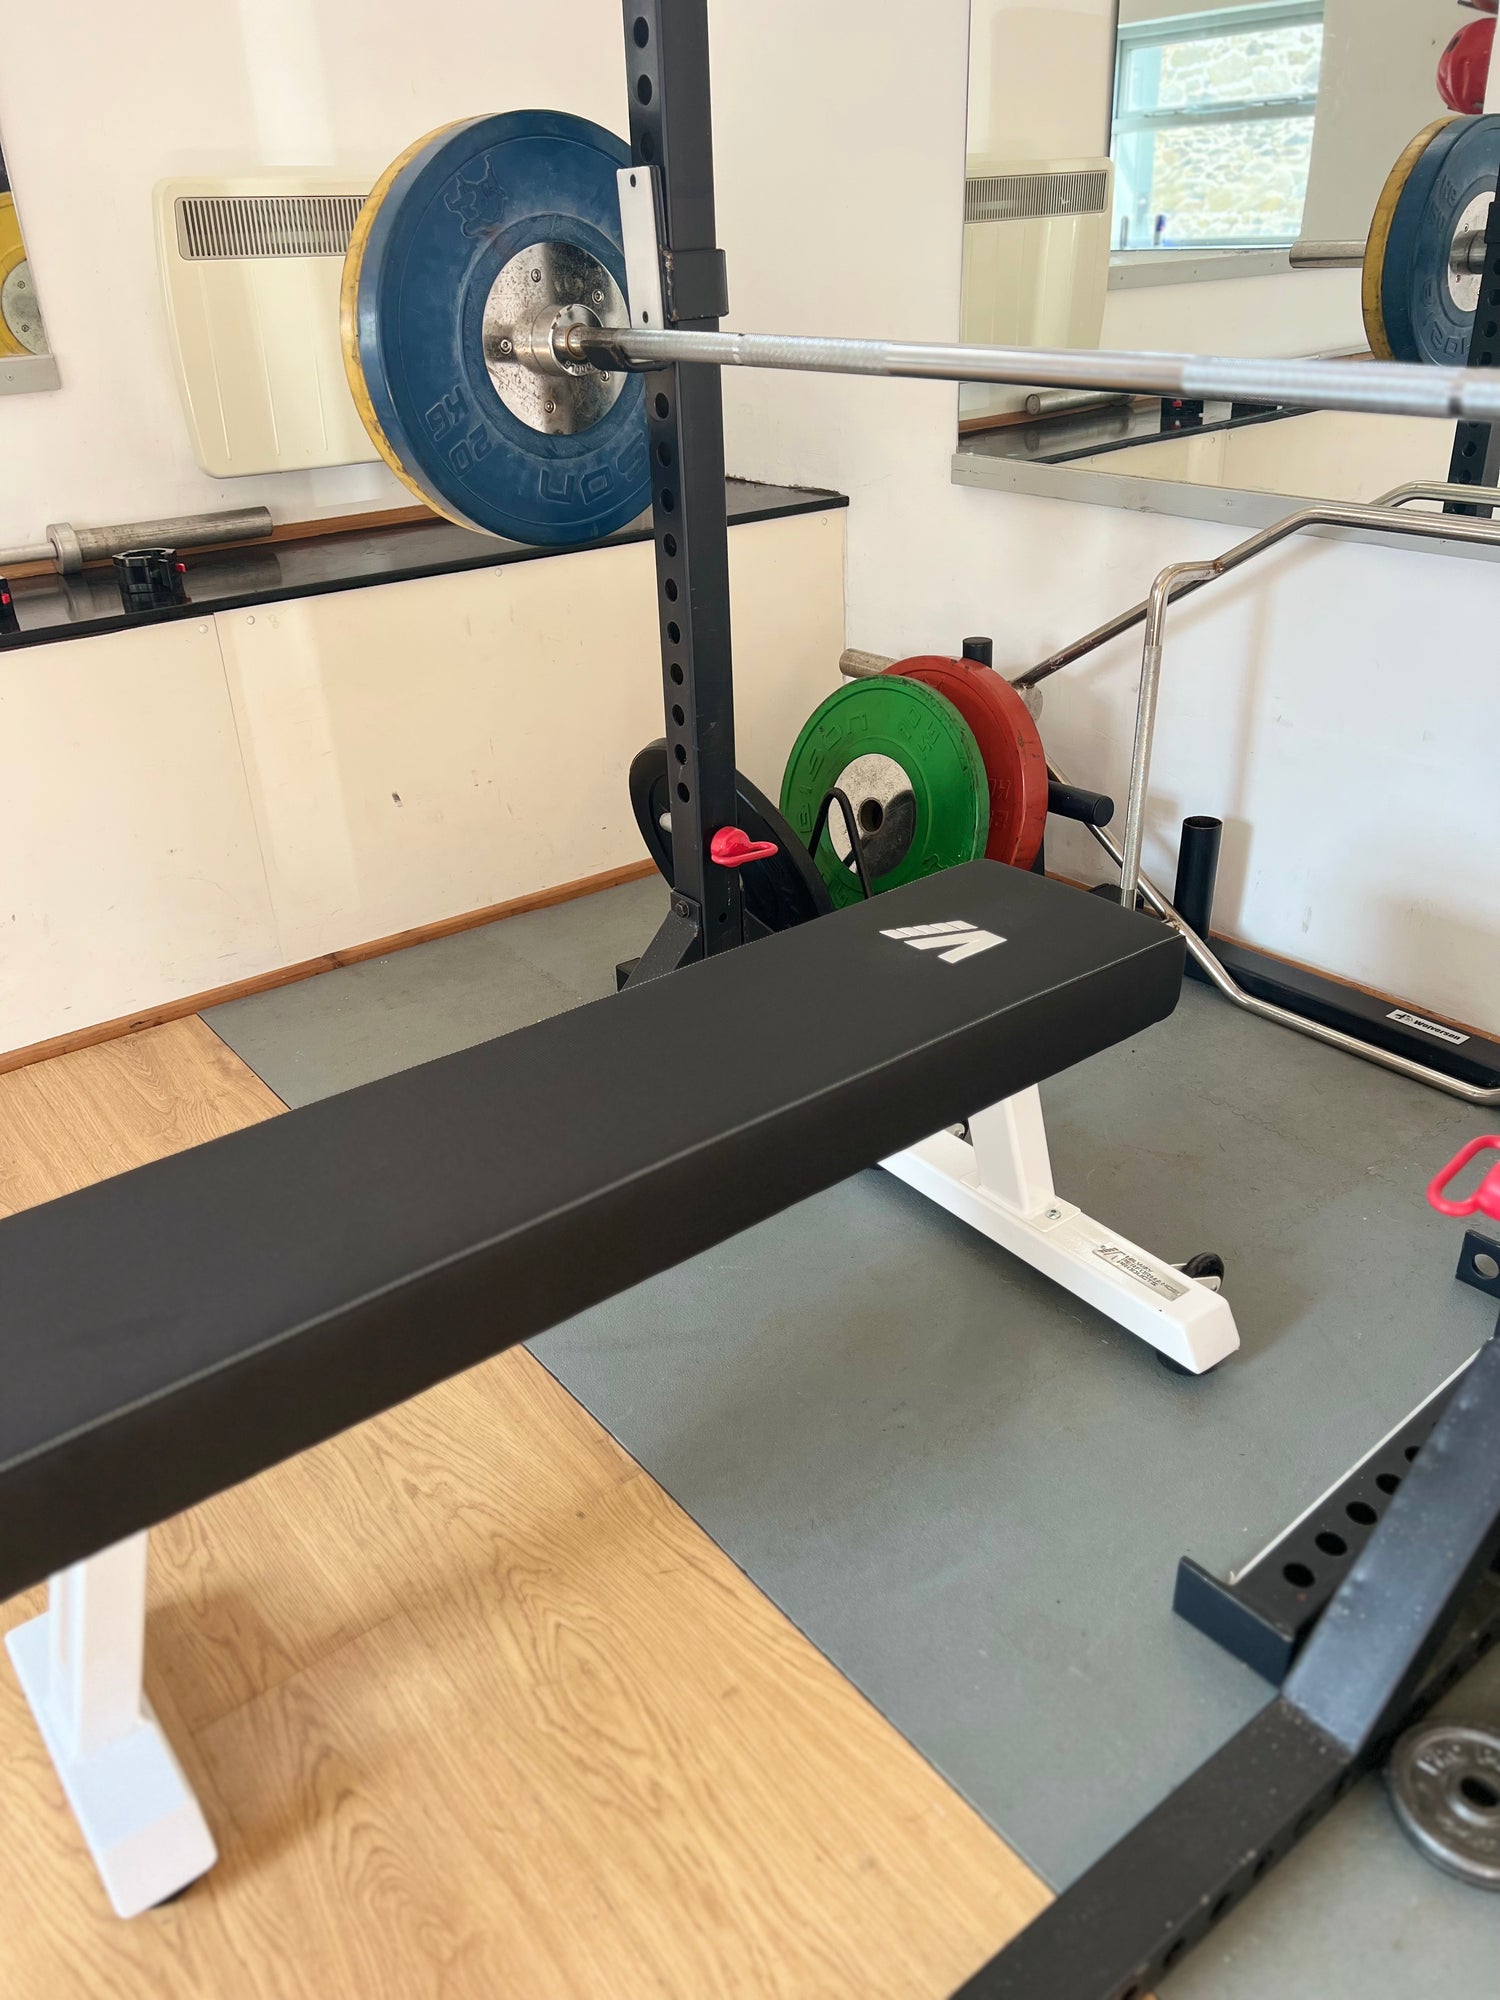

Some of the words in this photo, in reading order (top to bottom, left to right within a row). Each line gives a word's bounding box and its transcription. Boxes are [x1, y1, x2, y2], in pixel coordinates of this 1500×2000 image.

[425, 384, 470, 441] KG
[448, 422, 492, 479] 20
[1413, 1019, 1461, 1041] Wolverson
